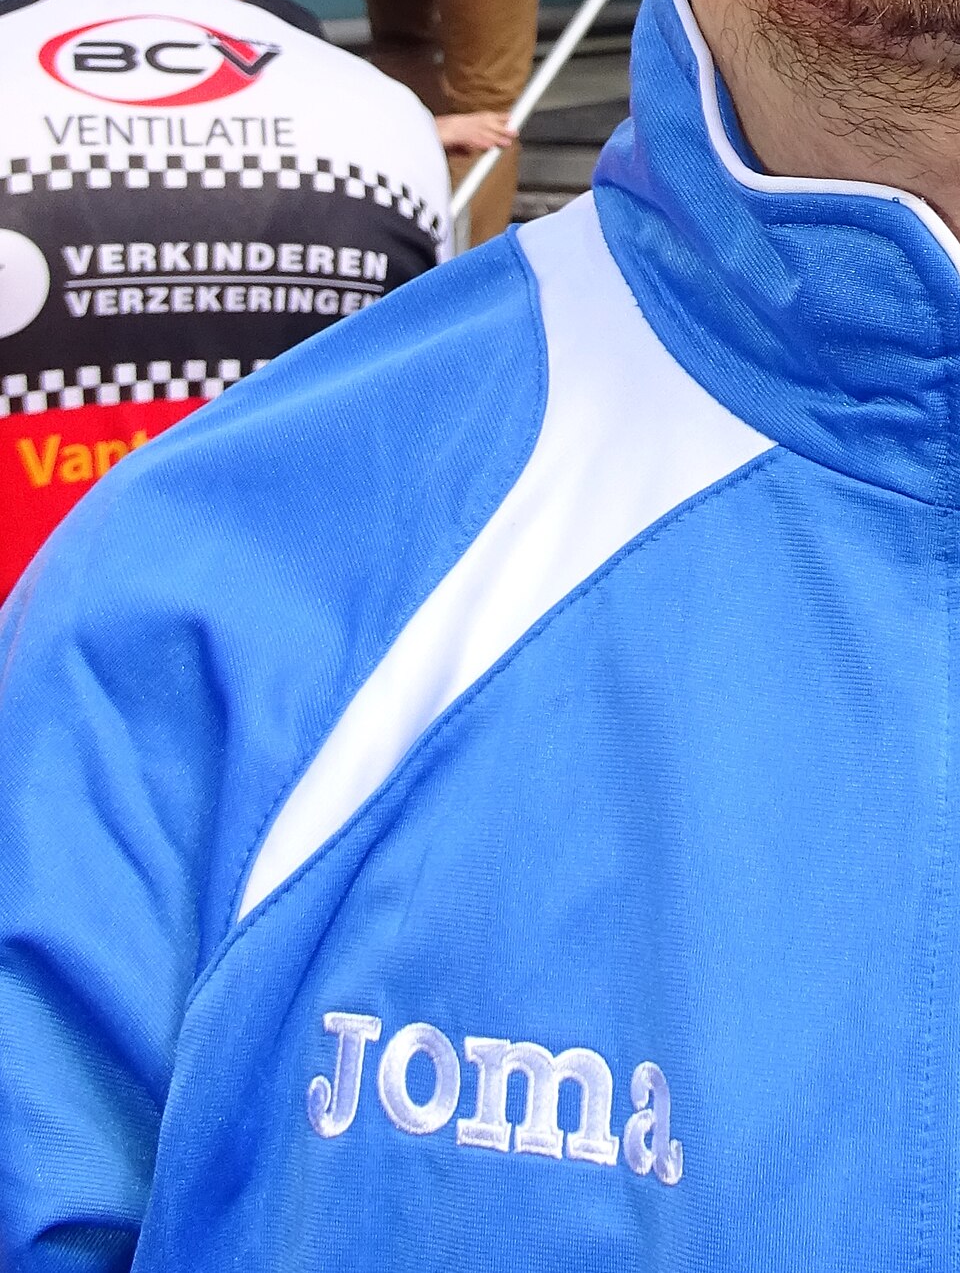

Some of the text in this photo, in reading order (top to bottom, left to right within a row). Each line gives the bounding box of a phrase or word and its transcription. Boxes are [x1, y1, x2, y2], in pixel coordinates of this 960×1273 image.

[73, 36, 282, 78] BCV
[44, 114, 295, 148] VENTILATIE
[62, 241, 389, 282] VERKINDEREN
